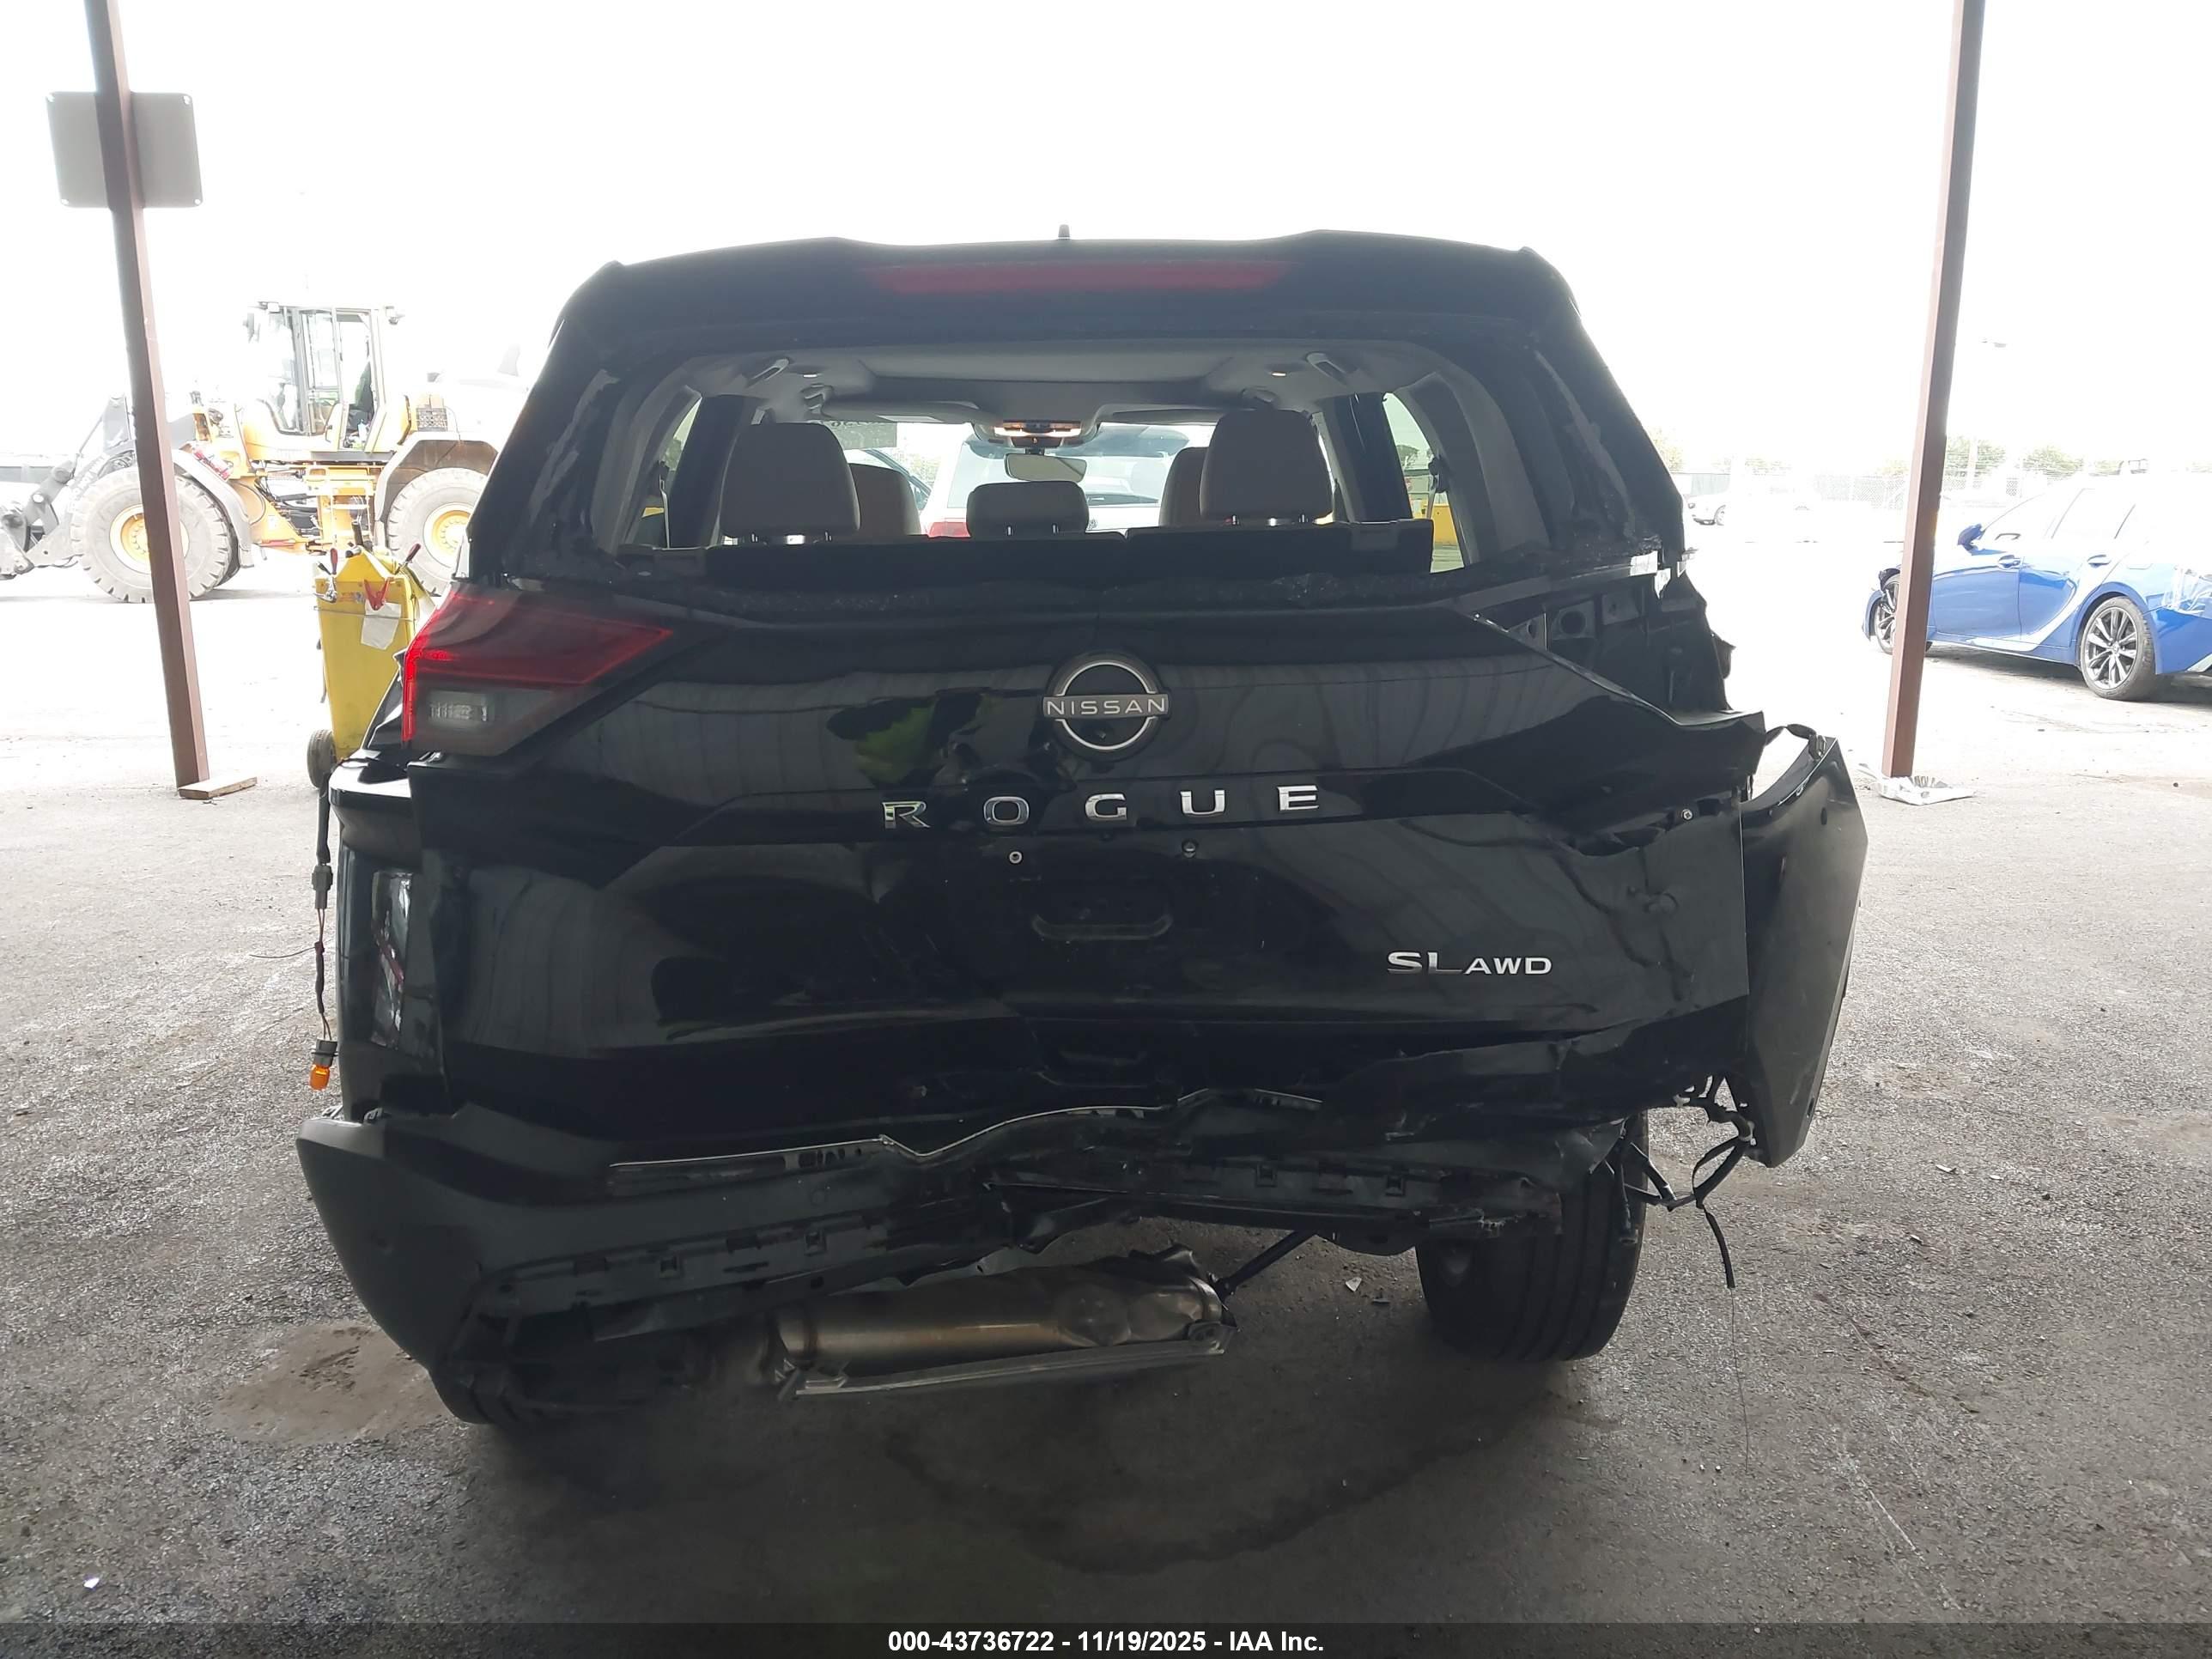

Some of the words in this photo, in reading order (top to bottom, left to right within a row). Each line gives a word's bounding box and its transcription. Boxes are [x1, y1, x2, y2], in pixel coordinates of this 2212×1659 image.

[1046, 696, 1166, 717] NISSAN
[881, 784, 1320, 830] ROGUE
[1387, 951, 1462, 975] SL
[1462, 957, 1552, 975] AWD
